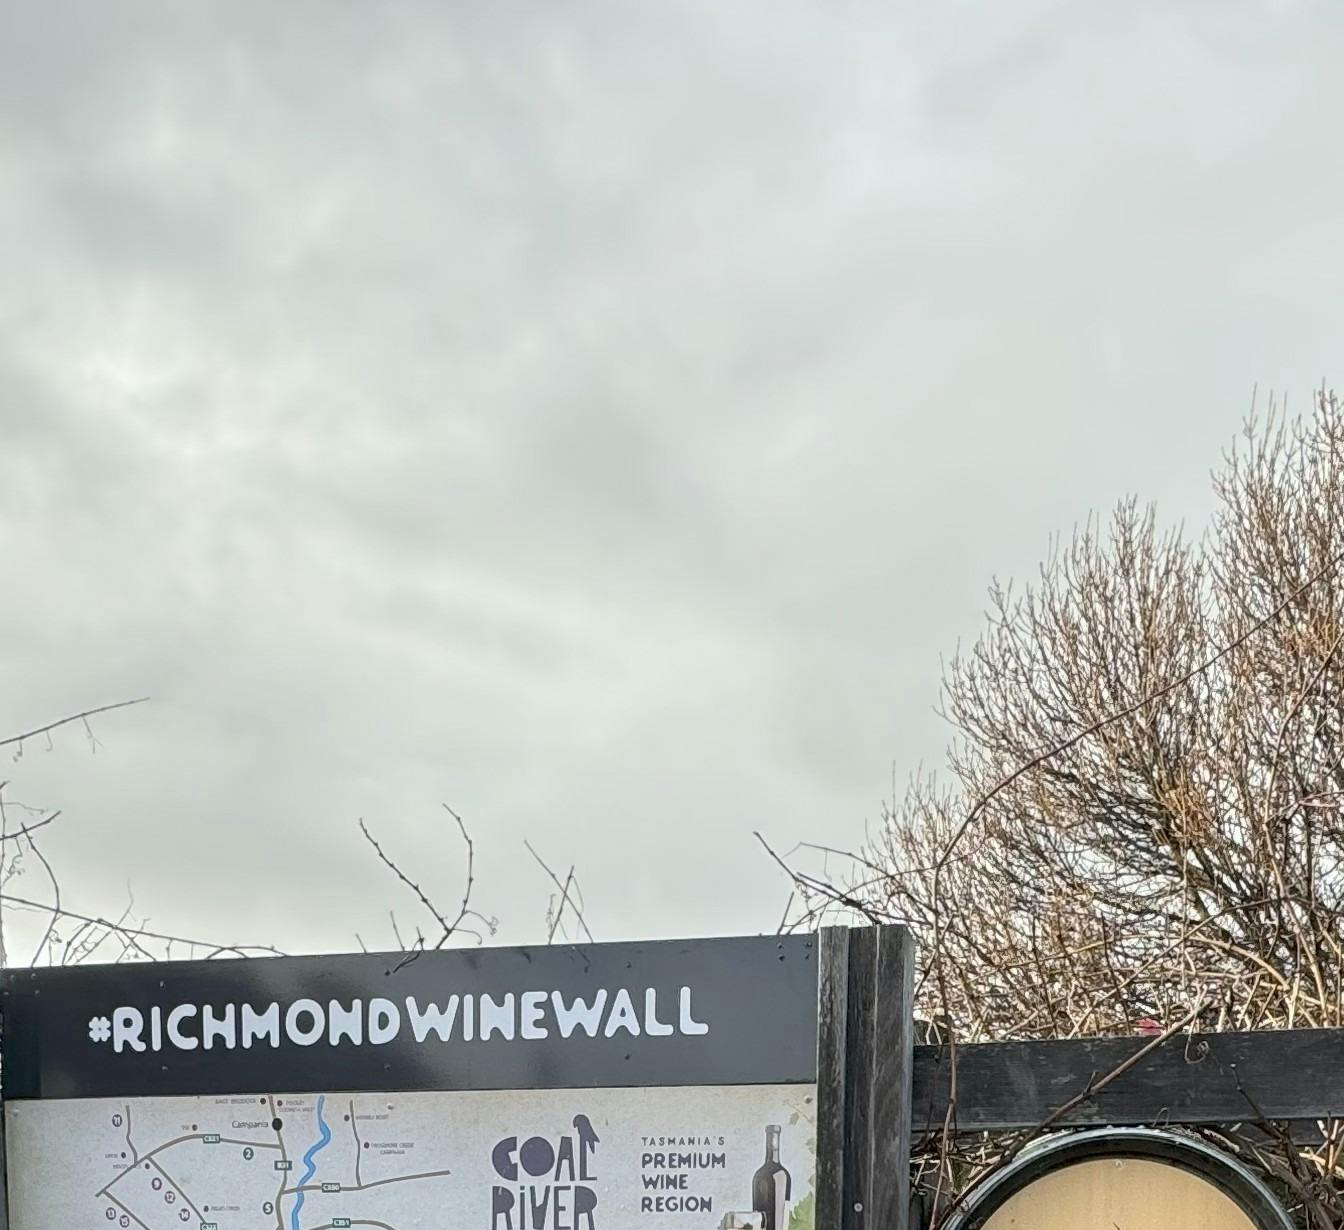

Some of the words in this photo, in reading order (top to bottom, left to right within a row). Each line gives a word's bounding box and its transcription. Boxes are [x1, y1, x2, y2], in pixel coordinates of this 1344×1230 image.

[88, 986, 709, 1053] #RICHMONDWINEWALL
[641, 1136, 726, 1146] TASMANIA'S
[492, 1134, 599, 1181] COAL
[641, 1153, 726, 1169] PREMIUM
[641, 1174, 689, 1190] WINE
[641, 1196, 713, 1213] REGION
